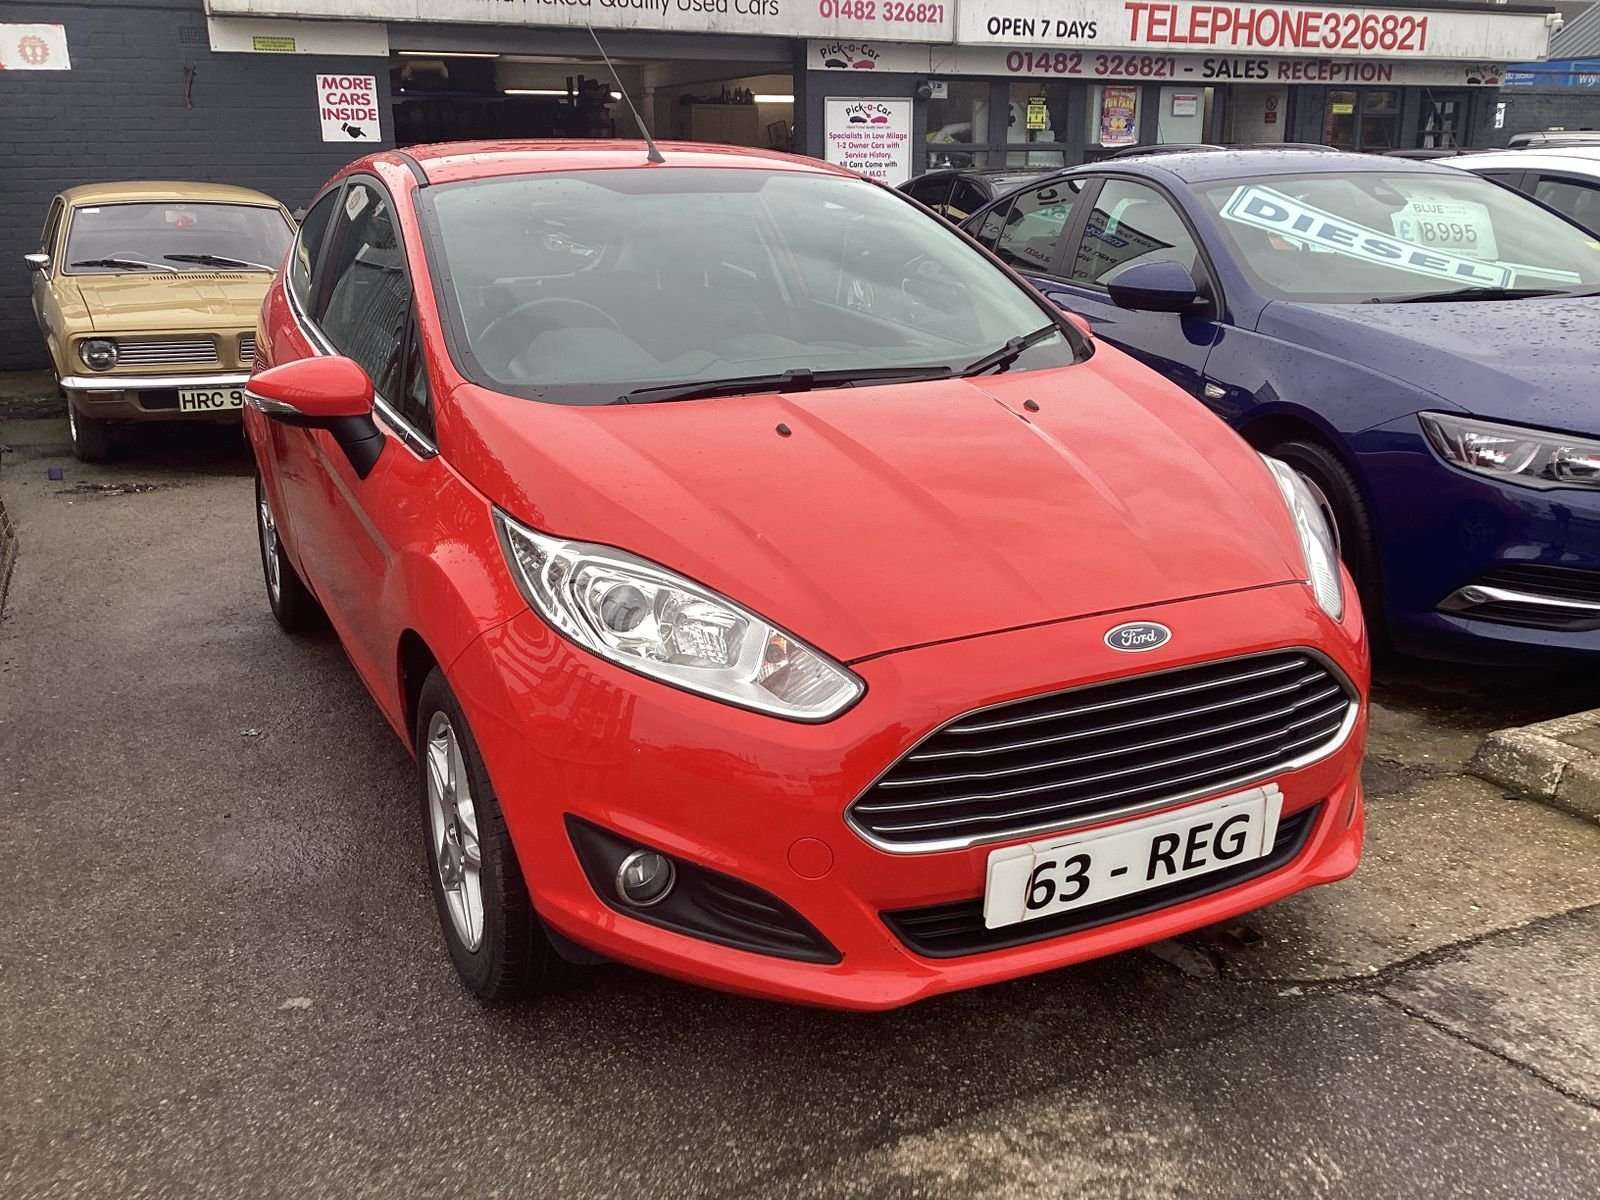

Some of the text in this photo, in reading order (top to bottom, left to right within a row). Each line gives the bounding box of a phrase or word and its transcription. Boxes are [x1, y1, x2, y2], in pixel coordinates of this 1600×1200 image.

[735, 0, 780, 16] Cars
[819, 0, 944, 24] 01482 326821
[986, 15, 1098, 39] OPEN 7 DAYS
[819, 40, 881, 60] Pick-a-Car
[1006, 49, 1083, 74] 01482
[1094, 54, 1176, 77] 326821
[1202, 58, 1269, 80] SALES
[1276, 60, 1393, 82] RECEPTION
[321, 76, 373, 91] MORE
[326, 92, 371, 106] CARS
[321, 108, 377, 121] INSIDE
[845, 102, 892, 117] Pick-a-Car
[828, 131, 862, 141] Specialists
[864, 131, 871, 139] in
[886, 131, 907, 141] Milage
[836, 142, 847, 150] 1-2
[886, 141, 900, 149] with
[844, 151, 869, 159] Service
[1412, 203, 1445, 214] BLUE
[1243, 196, 1495, 282] DIESEL
[181, 390, 243, 410] HRC 9
[1121, 627, 1157, 646] Ford
[1024, 813, 1250, 911] 63 - REG
